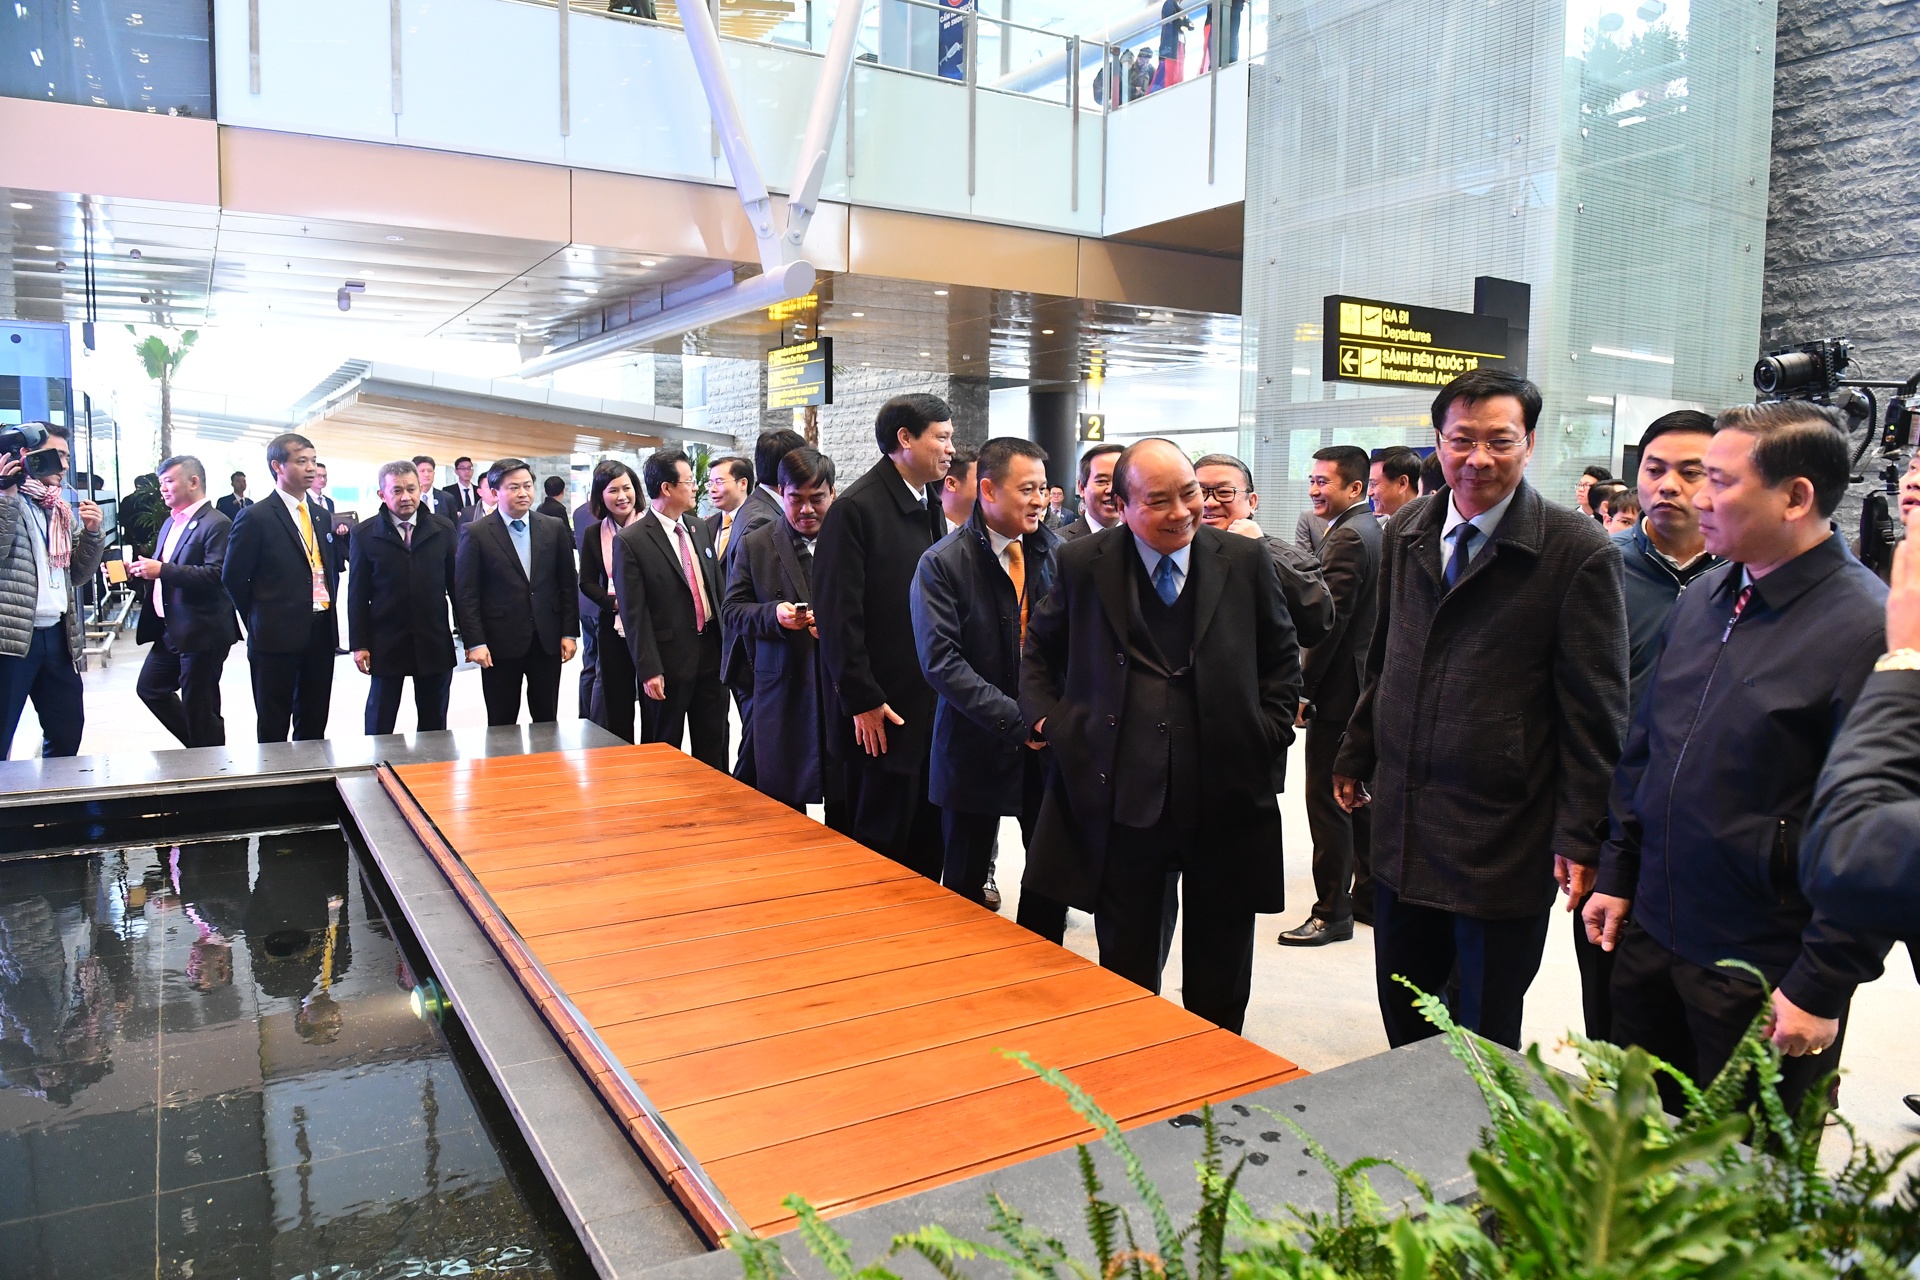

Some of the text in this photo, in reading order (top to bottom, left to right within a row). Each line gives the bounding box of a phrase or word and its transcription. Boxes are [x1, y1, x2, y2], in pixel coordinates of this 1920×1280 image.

[1382, 308, 1410, 325] GA ĐI
[1382, 324, 1432, 343] Departures
[1382, 347, 1412, 366] SẢNH
[1382, 366, 1436, 384] International
[1088, 416, 1100, 438] 2
